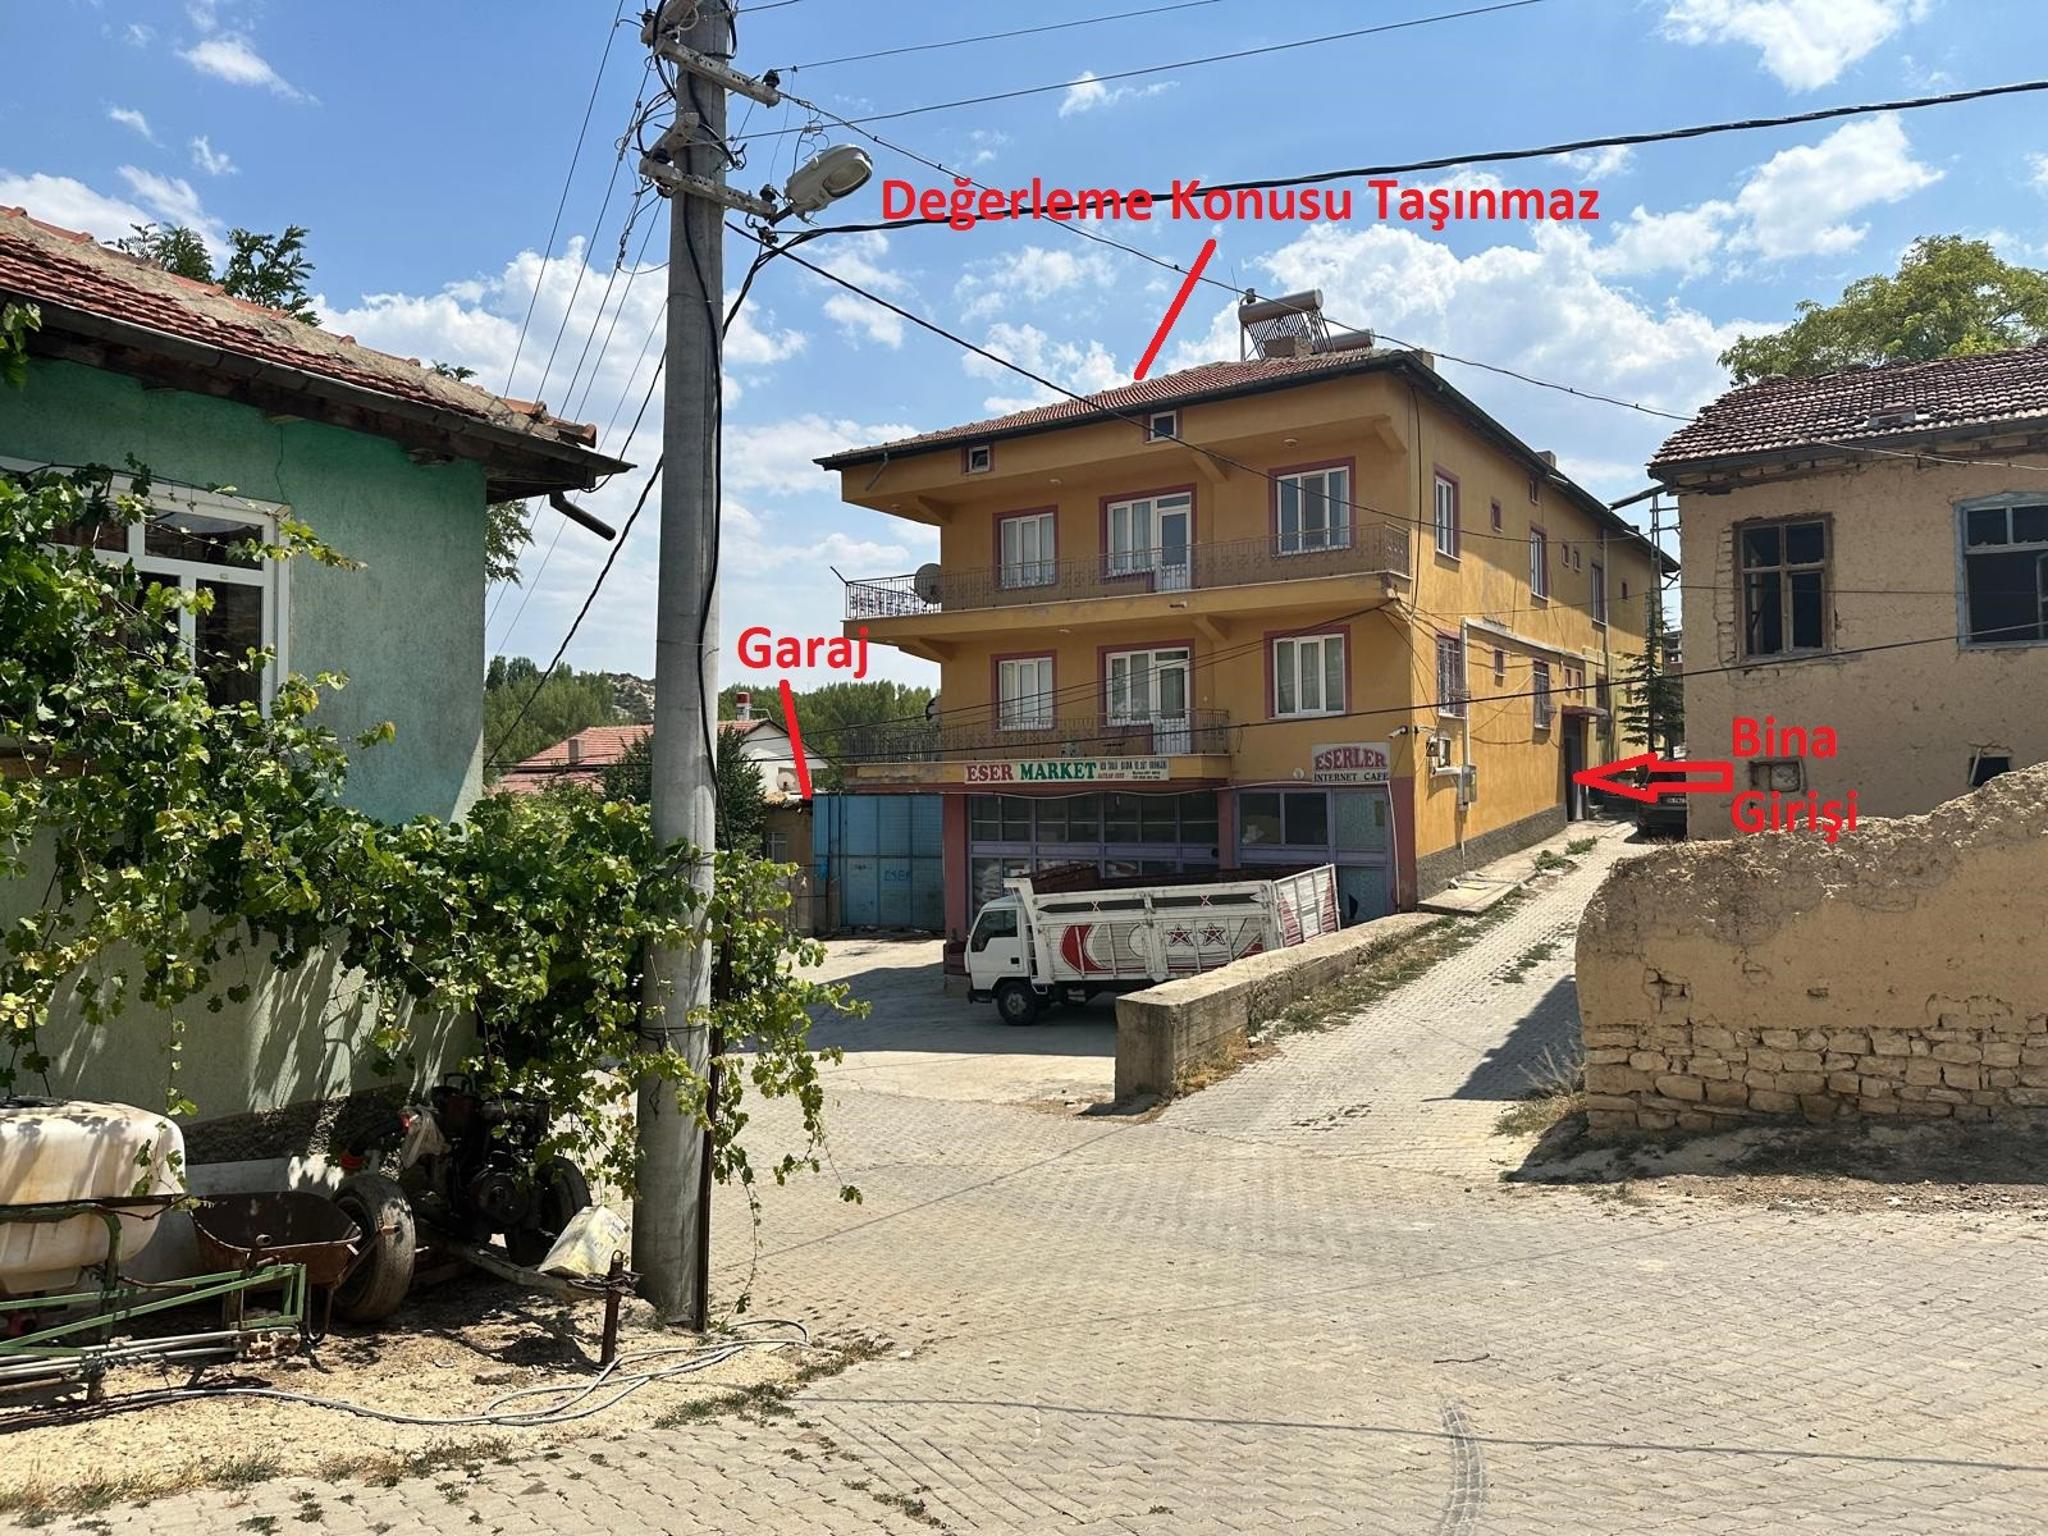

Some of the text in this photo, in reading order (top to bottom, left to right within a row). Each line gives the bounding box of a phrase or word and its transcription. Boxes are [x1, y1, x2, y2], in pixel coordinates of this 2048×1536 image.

[1315, 747, 1387, 770] ESERLER
[966, 764, 1014, 781] ESER
[1020, 762, 1097, 780] MARKET
